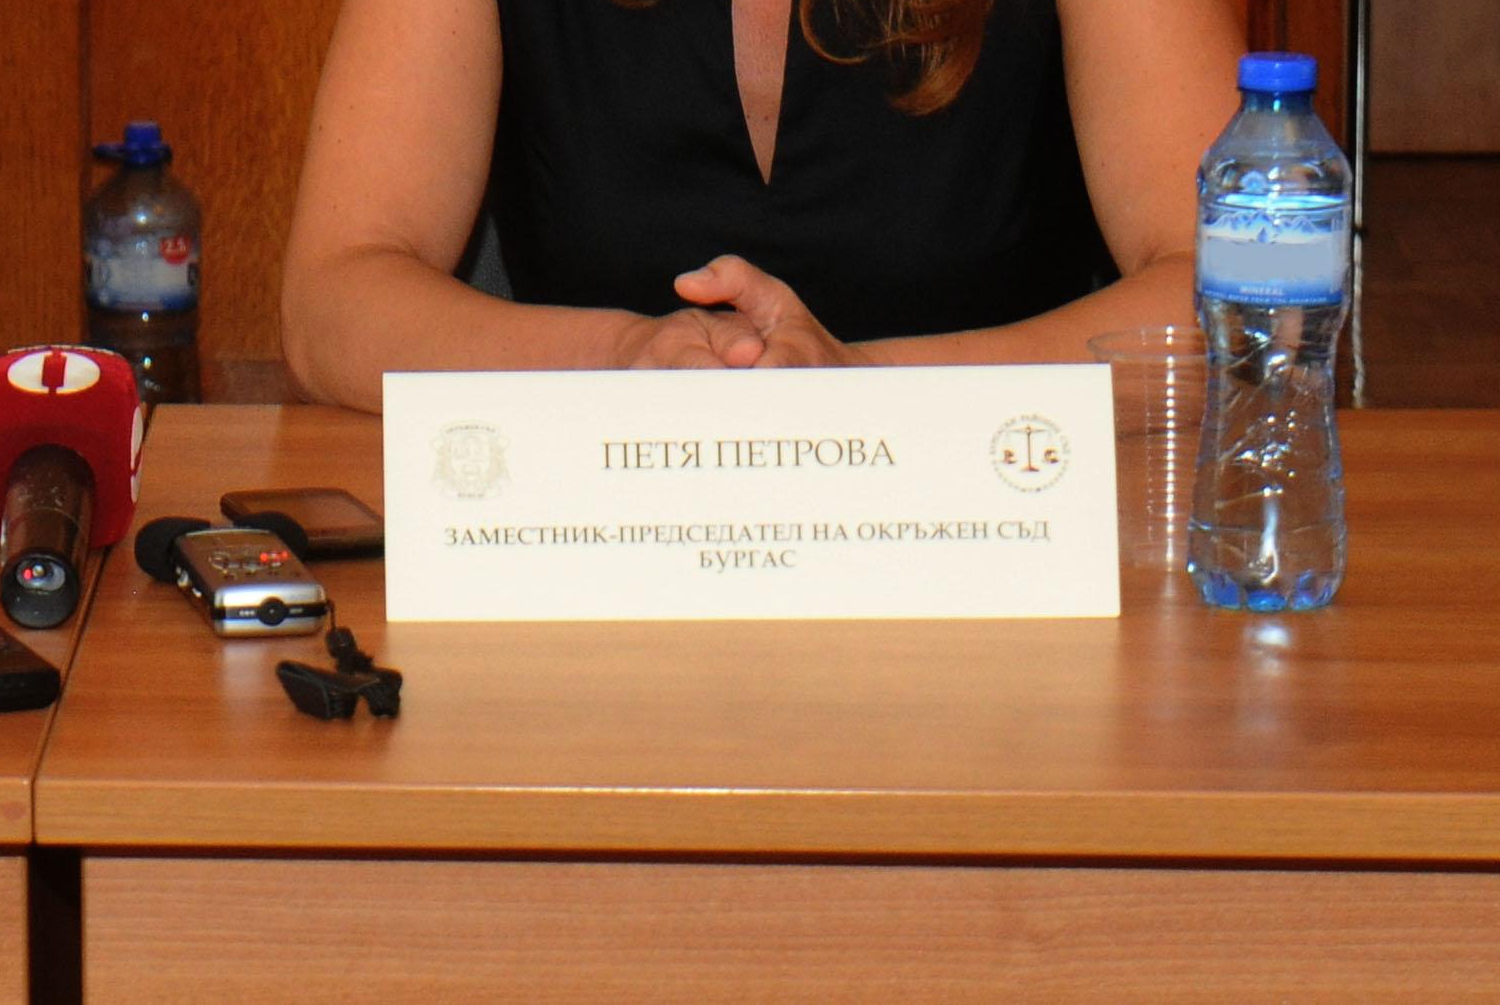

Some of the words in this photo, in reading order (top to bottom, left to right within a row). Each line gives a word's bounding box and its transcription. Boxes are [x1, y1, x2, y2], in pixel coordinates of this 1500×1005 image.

[602, 440, 702, 471] ПЕТЯ
[715, 438, 896, 469] ПЕТРОВА
[444, 524, 803, 546] ЗАМЕСТНИК-ПРЕДСЕДАТЕЛ
[812, 523, 848, 542] НА
[857, 522, 989, 542] ОКРЪЖЕН
[997, 520, 1051, 544] СЪД
[698, 549, 797, 573] БУРГАС
